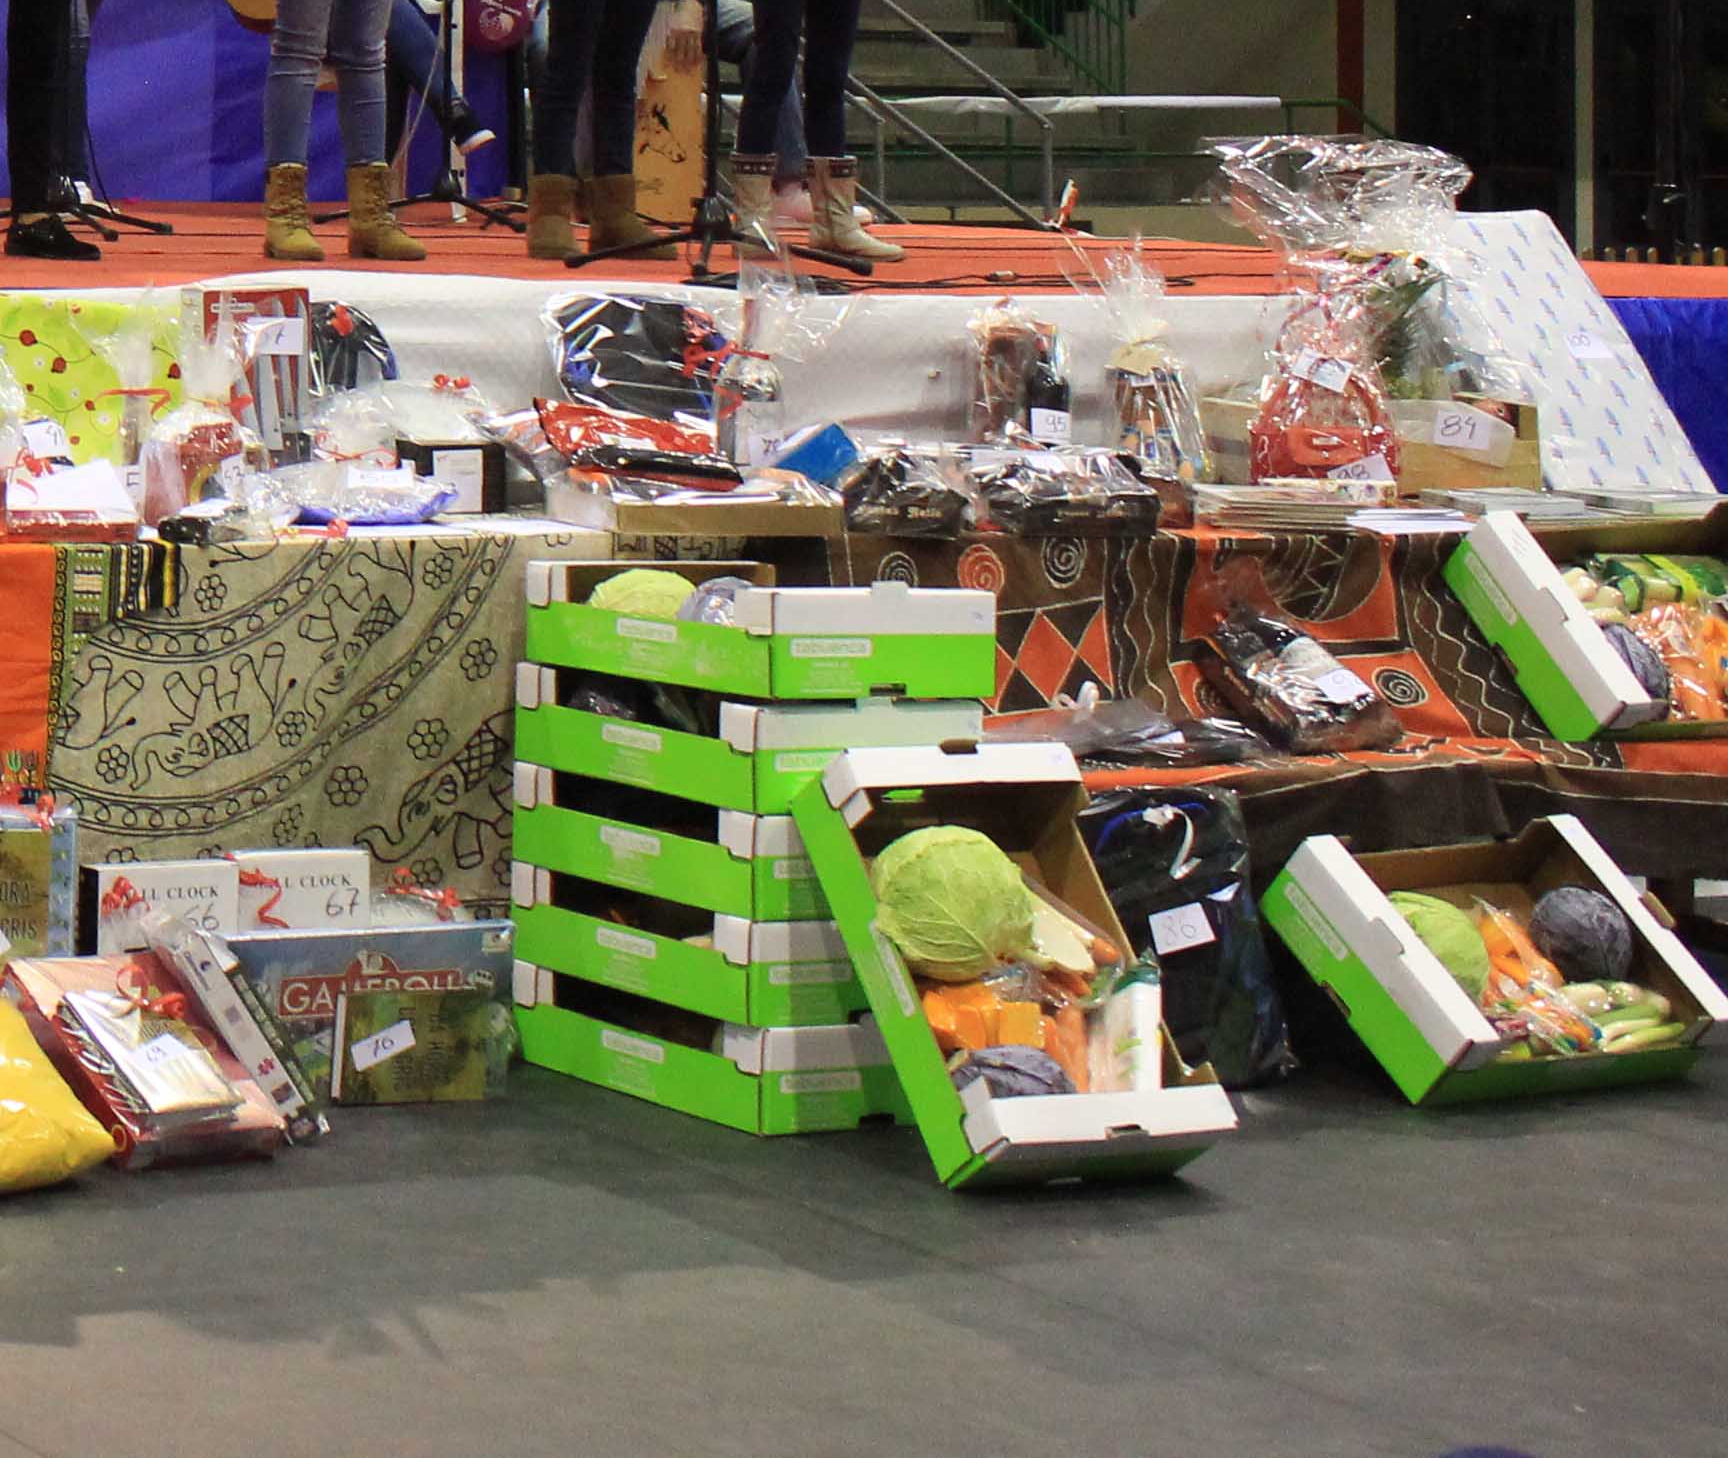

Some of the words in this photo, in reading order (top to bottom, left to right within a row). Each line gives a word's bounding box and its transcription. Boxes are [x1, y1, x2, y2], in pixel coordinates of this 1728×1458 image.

[1439, 414, 1477, 440] 84
[299, 874, 352, 889] CLOCK
[166, 885, 219, 900] CLOCK
[325, 887, 361, 917] 67
